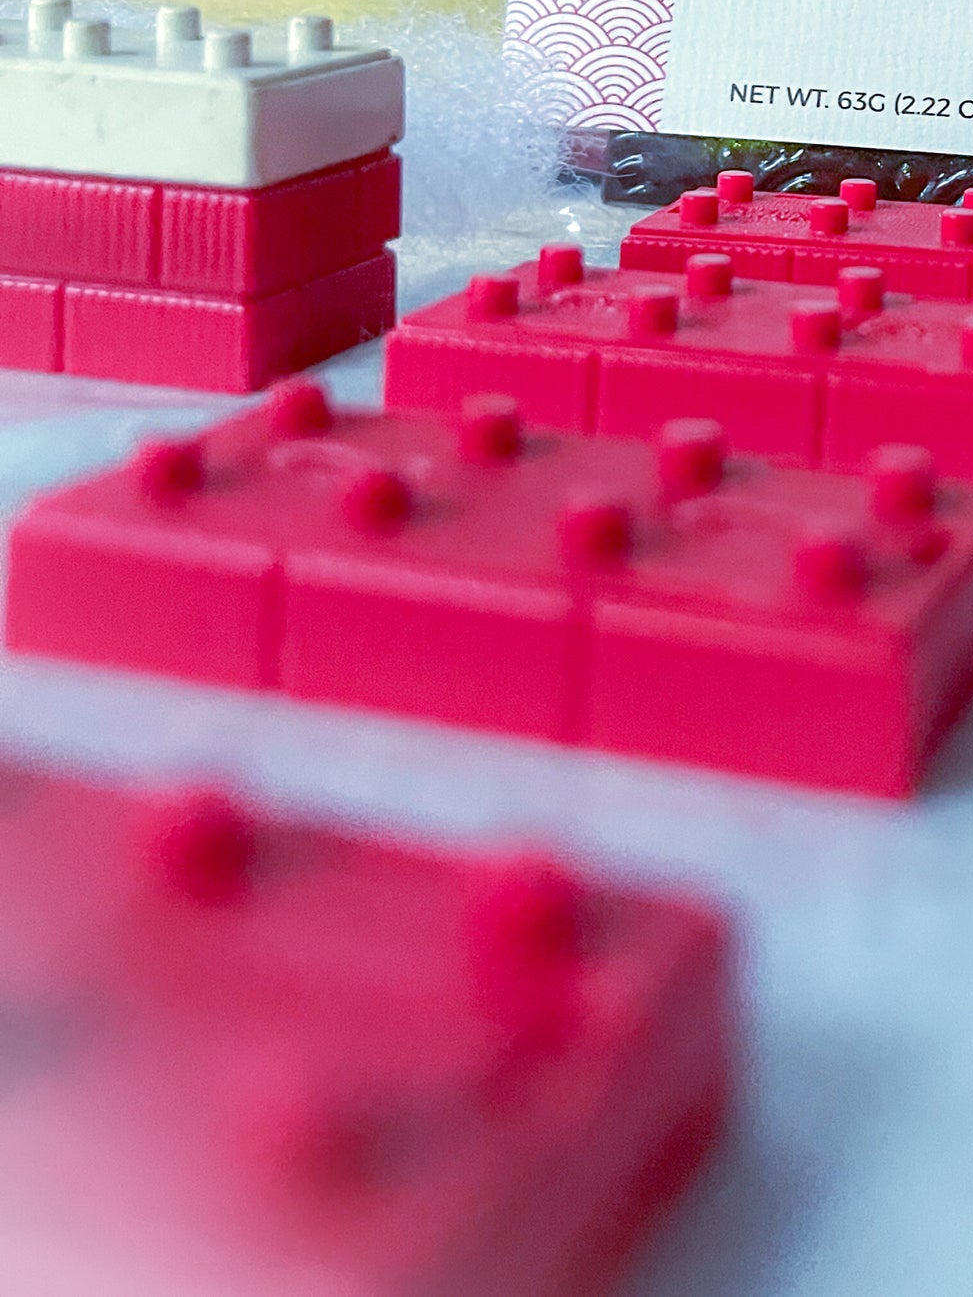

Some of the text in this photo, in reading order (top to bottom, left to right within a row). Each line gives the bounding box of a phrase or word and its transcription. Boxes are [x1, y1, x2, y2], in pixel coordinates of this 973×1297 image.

[730, 83, 781, 105] NET
[786, 86, 829, 109] WT.
[837, 91, 886, 113] 63G
[894, 92, 951, 118] (2.22
